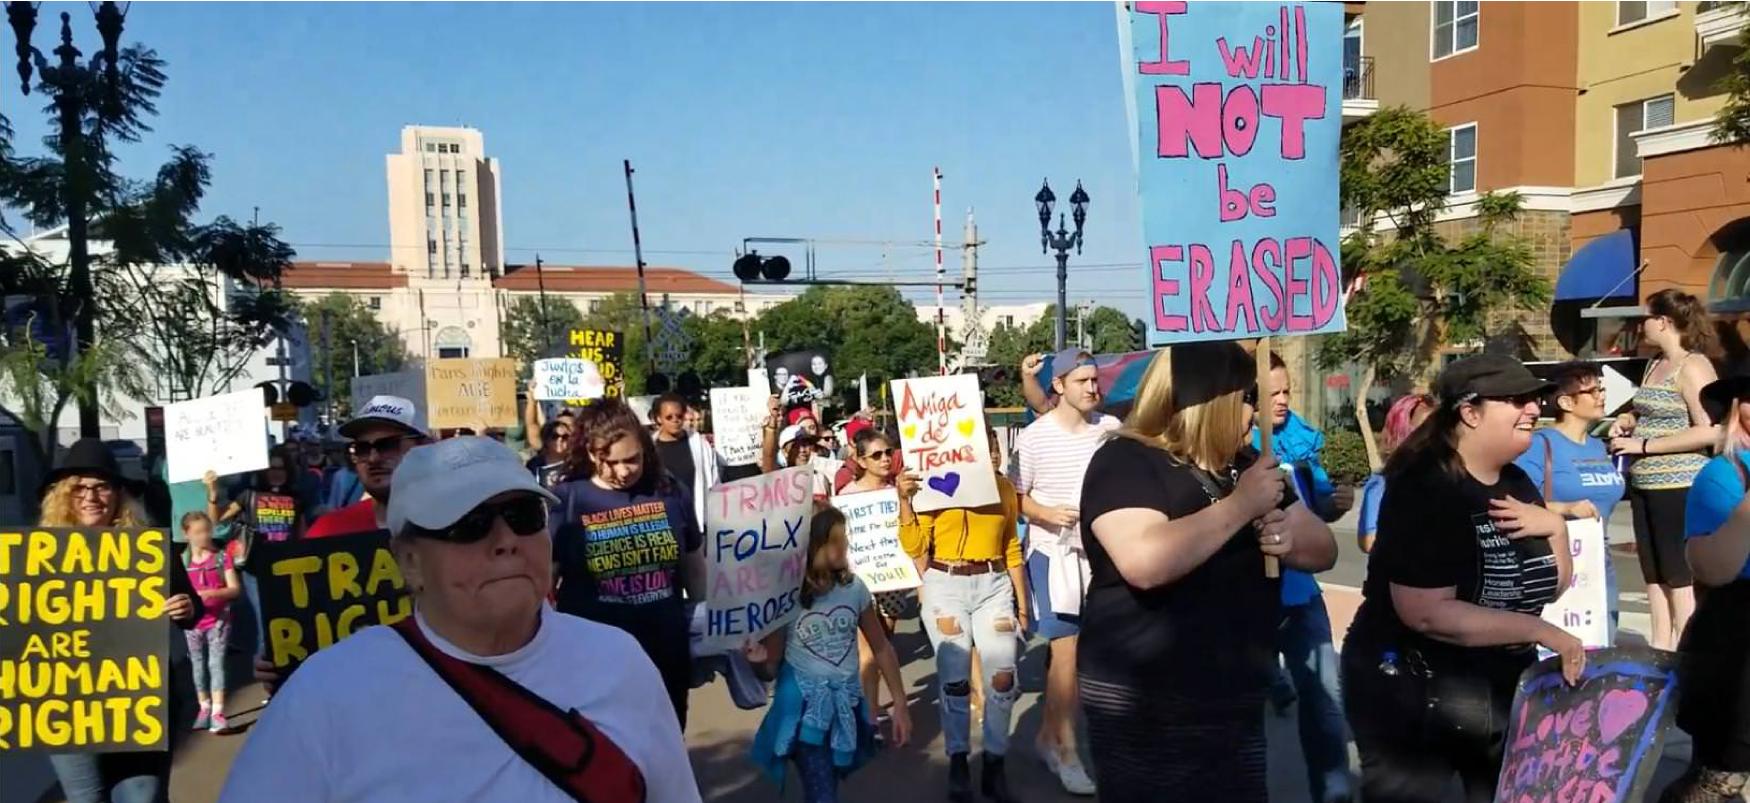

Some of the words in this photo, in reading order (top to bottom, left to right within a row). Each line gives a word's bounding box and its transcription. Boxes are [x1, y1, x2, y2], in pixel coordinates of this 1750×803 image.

[1135, 1, 1190, 75] I
[1216, 5, 1308, 82] will
[1155, 82, 1327, 159] NOT
[1217, 163, 1277, 222] be
[1150, 237, 1339, 333] ERASED
[569, 329, 614, 347] HEAR
[581, 348, 603, 362] US
[900, 381, 966, 427] Amiga
[921, 420, 950, 444] de
[582, 509, 609, 526] BLACK
[719, 470, 811, 520] TRANS
[585, 536, 634, 557] SCIENCE
[635, 534, 647, 549] IS
[649, 529, 677, 546] REAL
[587, 554, 622, 573] NEWS
[653, 544, 680, 561] FAKE
[716, 515, 804, 564] FOLX
[712, 566, 769, 598] ARE
[708, 587, 799, 637] HEROES
[21, 630, 92, 661] ARE
[1513, 700, 1593, 752] Love
